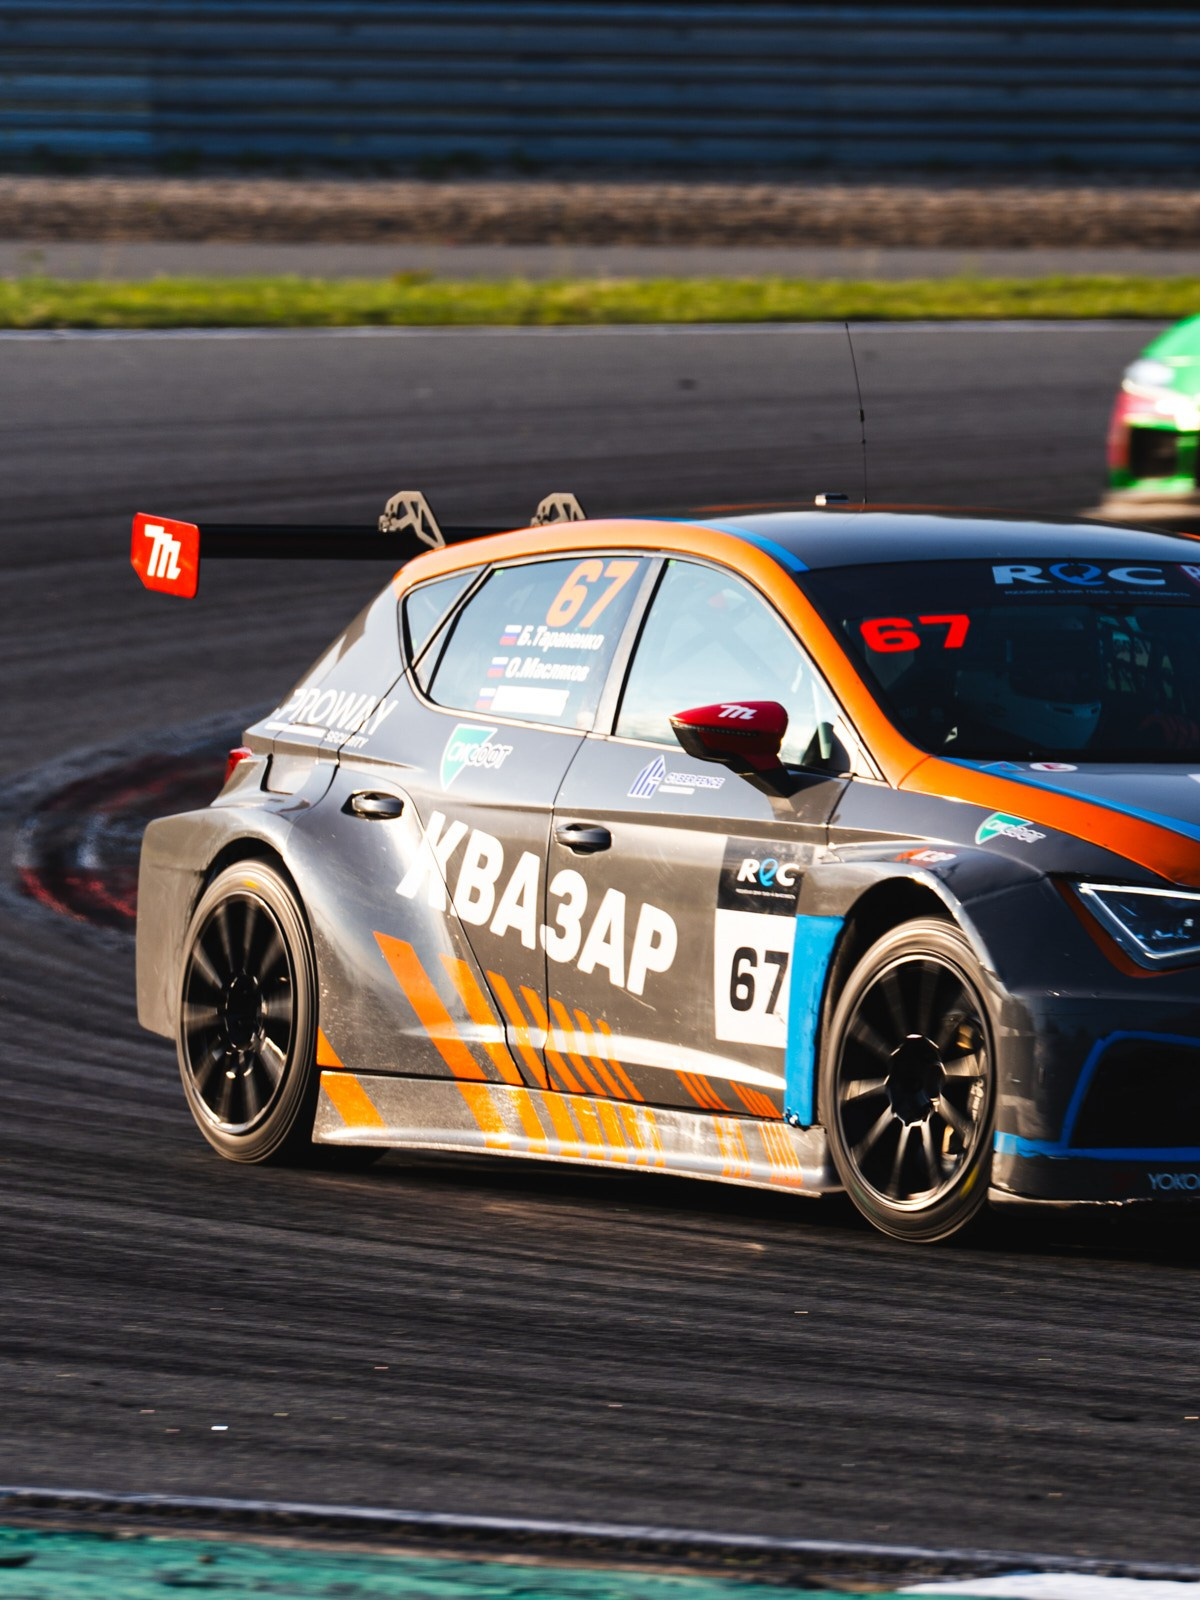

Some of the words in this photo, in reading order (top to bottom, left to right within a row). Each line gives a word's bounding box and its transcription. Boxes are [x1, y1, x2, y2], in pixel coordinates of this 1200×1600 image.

[545, 559, 640, 628] 67
[859, 614, 971, 653] 67
[274, 688, 399, 736] PROWAY
[395, 810, 678, 996] КВАЗАР
[729, 946, 790, 1015] 67
